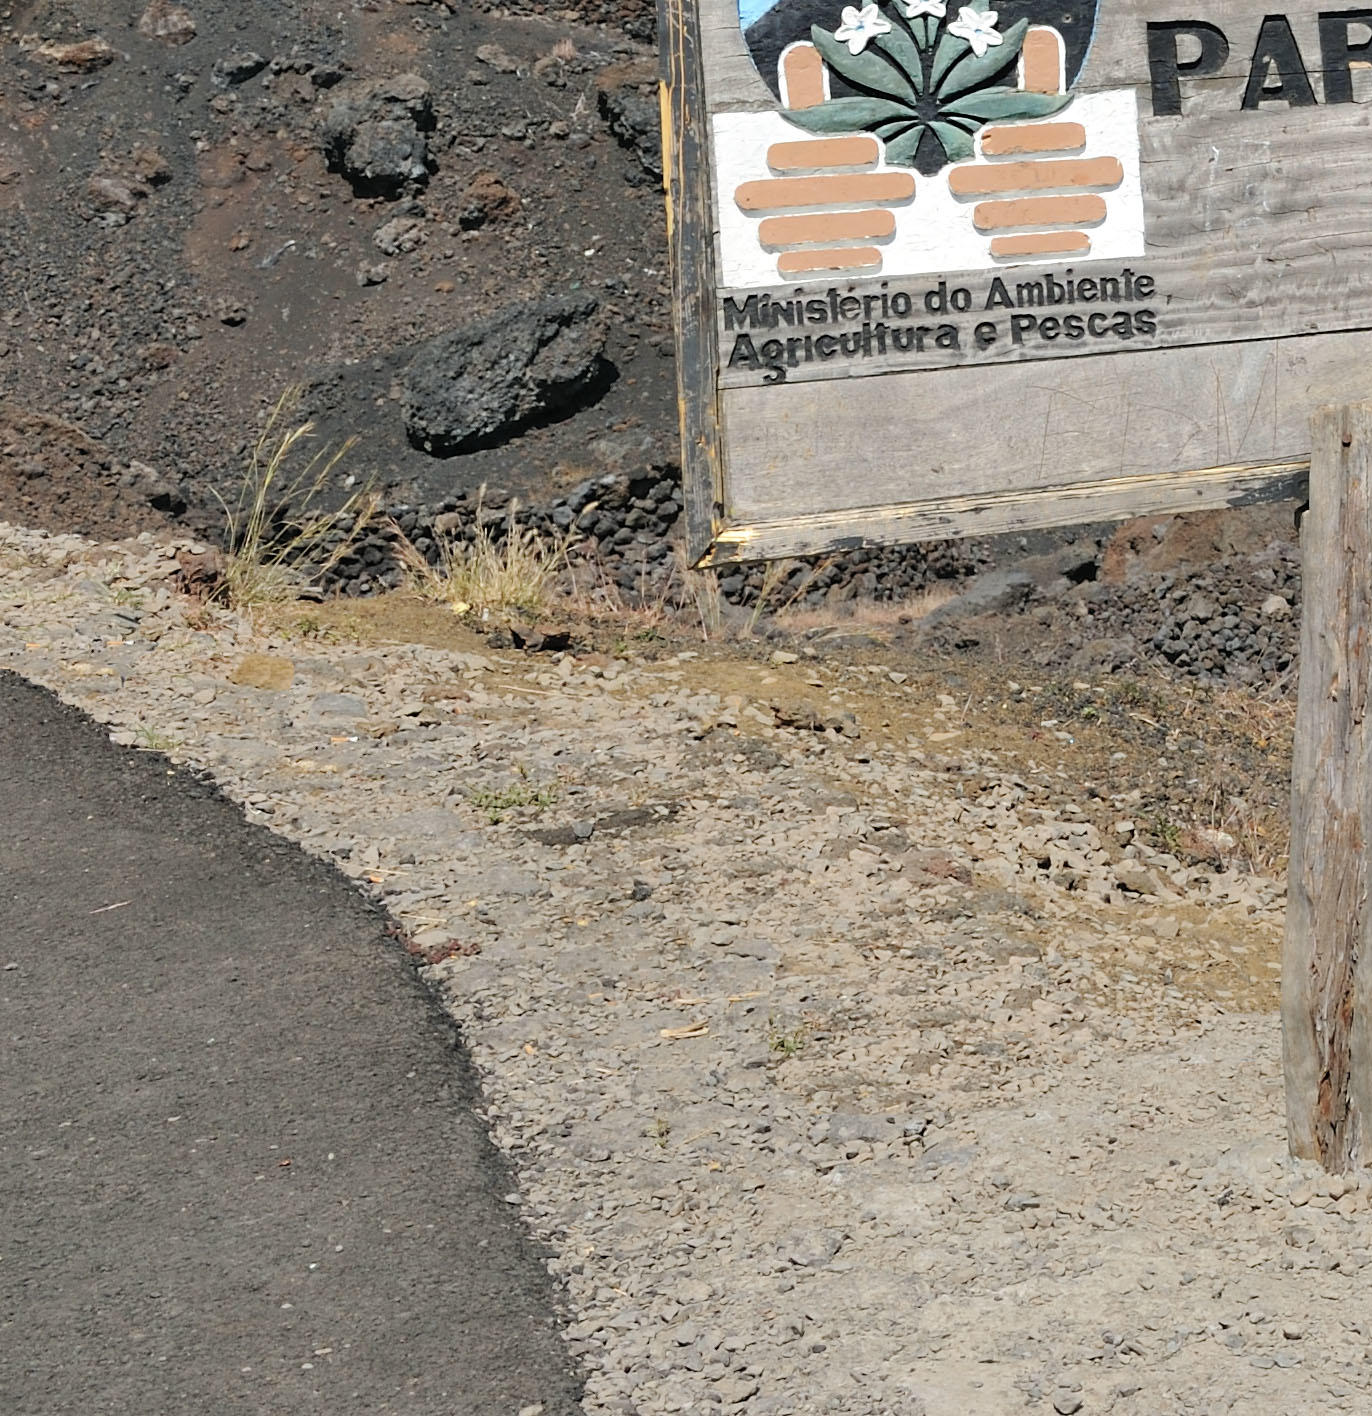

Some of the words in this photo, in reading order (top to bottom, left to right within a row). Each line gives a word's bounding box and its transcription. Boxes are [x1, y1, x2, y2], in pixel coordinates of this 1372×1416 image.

[722, 280, 912, 332] Ministério
[924, 281, 973, 314] do
[727, 322, 961, 384] Agricultura
[973, 320, 998, 352] e
[1010, 308, 1157, 345] Pescas
